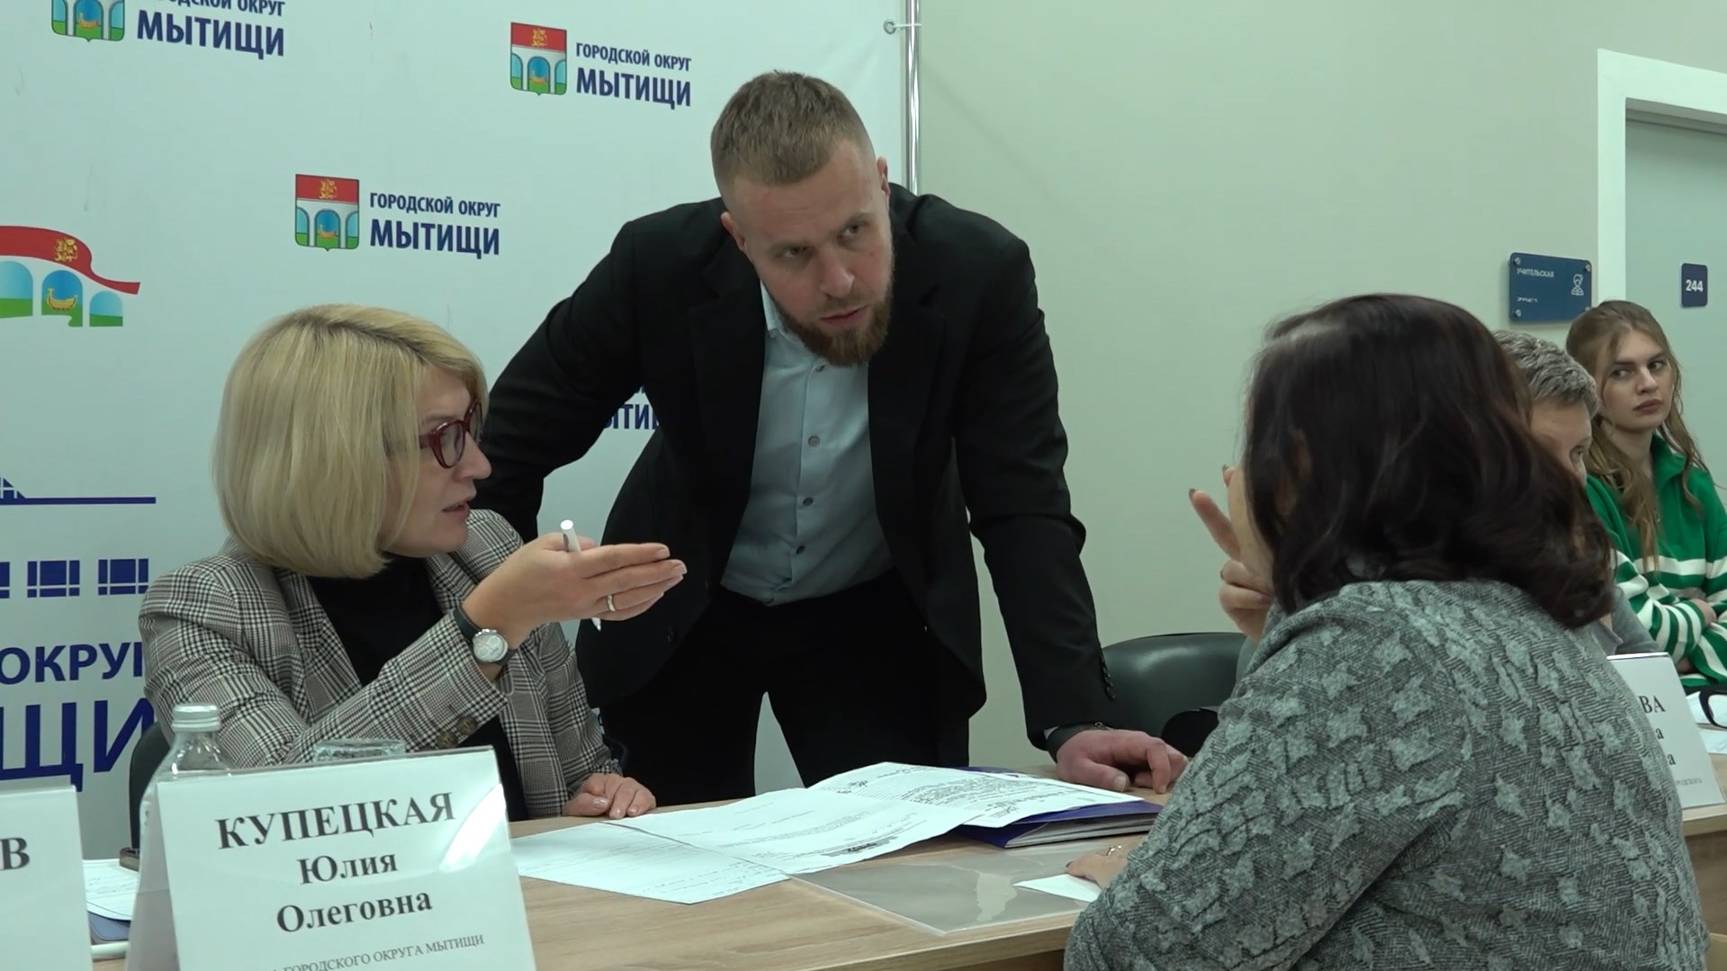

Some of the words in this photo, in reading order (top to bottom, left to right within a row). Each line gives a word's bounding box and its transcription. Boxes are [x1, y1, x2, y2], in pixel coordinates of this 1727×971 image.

[137, 10, 284, 60] МЫТИЩИ
[576, 42, 650, 66] ГОРОДСКОЙ
[654, 54, 692, 71] ОКРУГ
[576, 67, 691, 110] МЫТИЩИ
[370, 192, 454, 214] ГОРОДСКОЙ
[458, 200, 501, 218] ОКРУГ
[370, 219, 499, 260] МЫТИЩИ
[1685, 279, 1704, 292] 244
[214, 792, 456, 850] КУПЕЦКАЯ
[297, 854, 398, 885] Юлия
[277, 892, 432, 932] Олеговна
[373, 945, 424, 962] ОКРУГА
[426, 934, 484, 953] МЫТИЩИ
